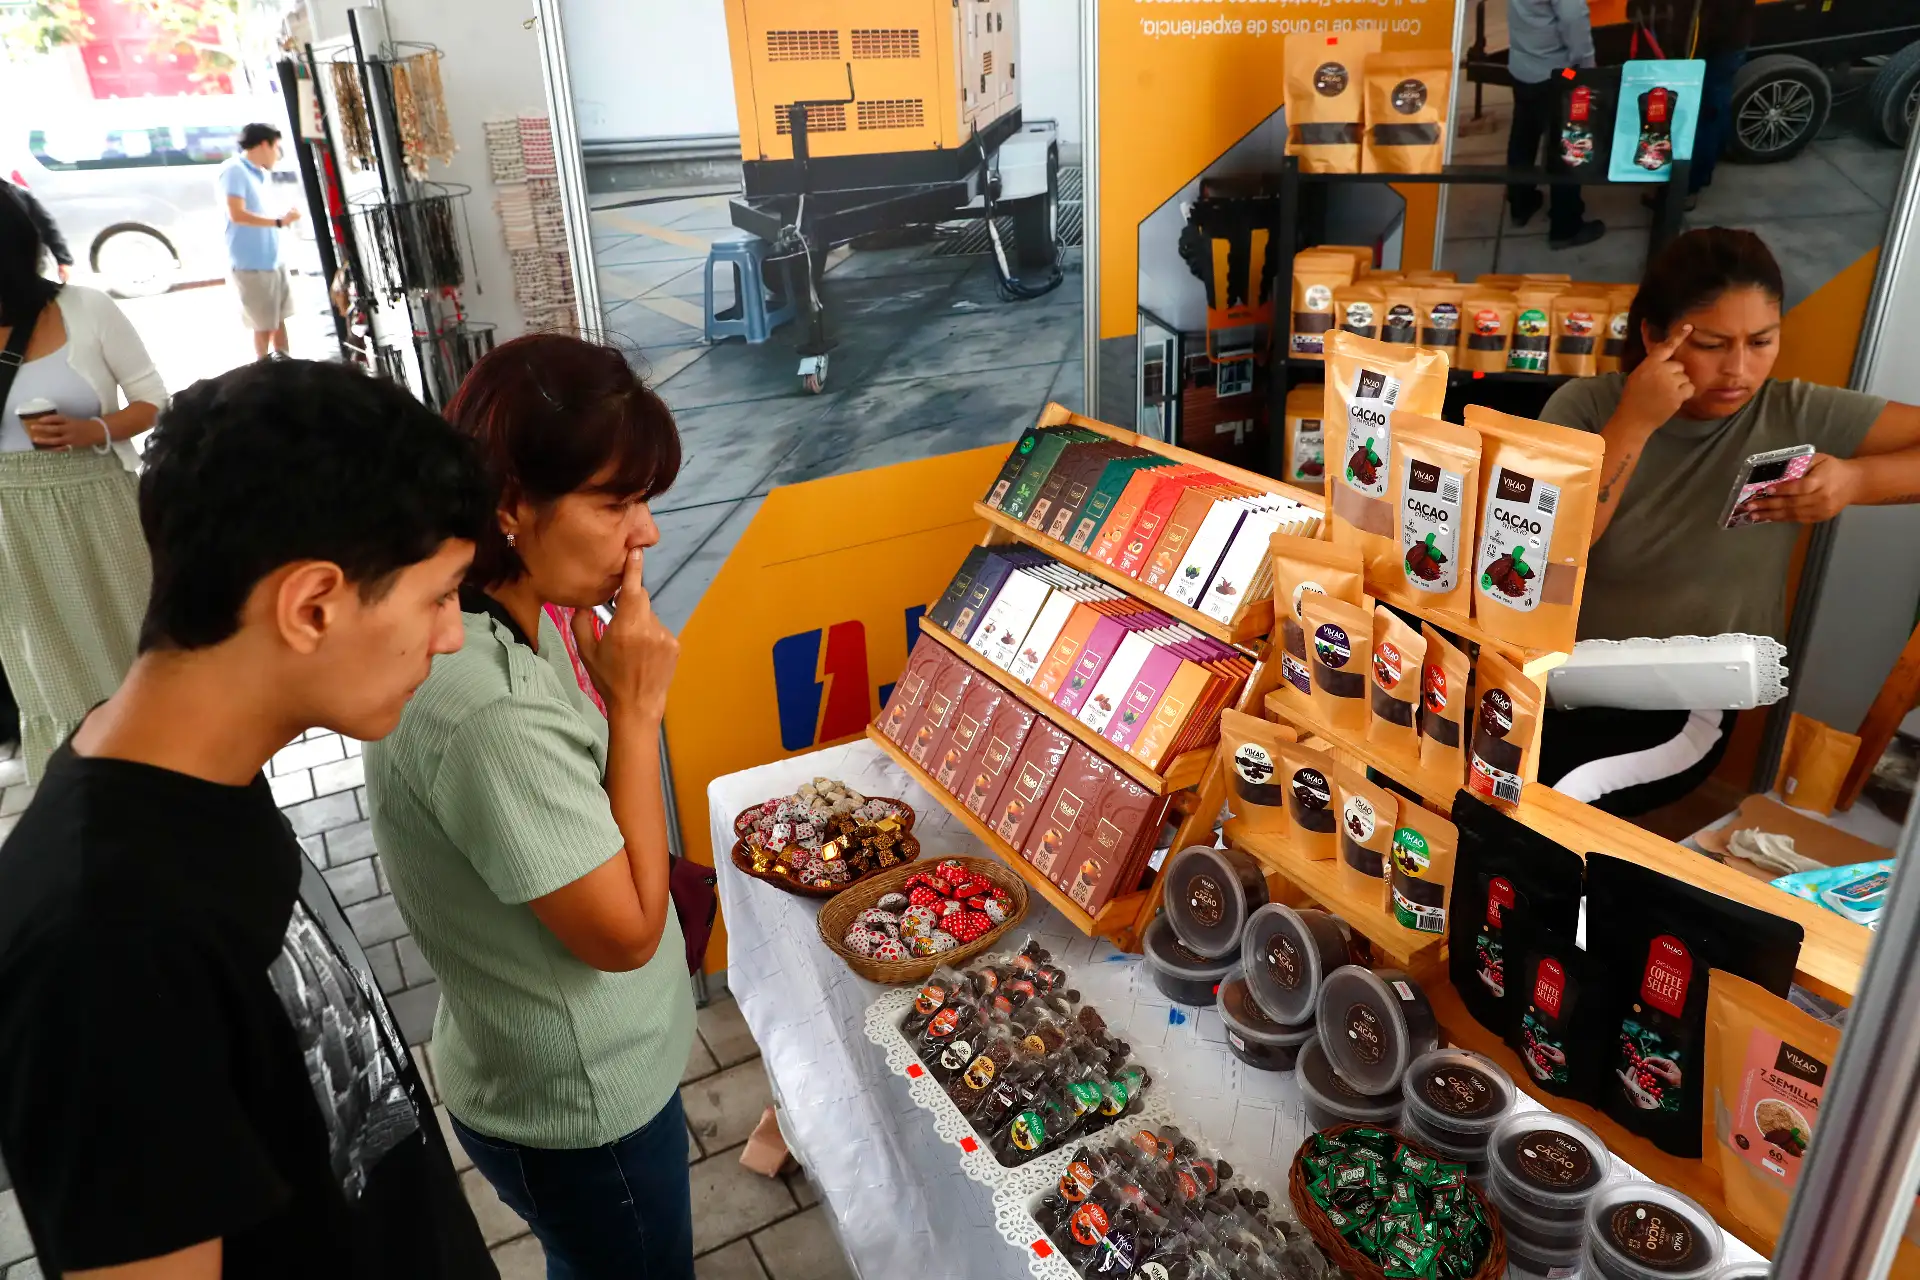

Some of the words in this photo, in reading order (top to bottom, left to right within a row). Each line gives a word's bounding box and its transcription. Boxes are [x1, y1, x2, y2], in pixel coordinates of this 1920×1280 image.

[1140, 13, 1242, 40] experiencia,
[1246, 19, 1268, 38] de
[1392, 17, 1421, 35] Con
[1352, 406, 1386, 426] CACAO
[1414, 469, 1434, 482] VIKAO
[1504, 476, 1526, 492] VIKAO
[1407, 498, 1448, 522] CACAO
[1494, 508, 1542, 535] CACAO
[1324, 625, 1344, 640] VIKAO
[1383, 644, 1400, 661] VIKAO
[1491, 690, 1510, 710] VIKAO
[1244, 747, 1265, 759] VIKAO
[1024, 773, 1037, 787] VIKAO
[1302, 772, 1323, 785] VIKAO
[1060, 800, 1075, 816] VIKAO
[1355, 798, 1372, 815] VIKAO
[1402, 830, 1424, 848] VIKAO
[1194, 891, 1216, 907] CACAO
[1662, 941, 1683, 956] VIKAO
[1274, 949, 1294, 972] CACAO
[1650, 965, 1683, 990] COFFEE
[1539, 980, 1560, 996] COFFEE
[1647, 977, 1682, 1001] SELECT
[1536, 988, 1559, 1007] SELECT
[1353, 1022, 1377, 1043] CACAO
[1786, 1050, 1818, 1074] VIKAO
[1448, 1077, 1474, 1102] CACAO
[1471, 1076, 1486, 1092] VIKAO
[1030, 1115, 1042, 1135] VIKAO
[1556, 1137, 1577, 1152] VIKAO
[1536, 1145, 1574, 1168] CACAO
[1768, 1149, 1783, 1160] 60
[1076, 1164, 1091, 1179] VIKAO
[1340, 1167, 1365, 1181] COCA
[1090, 1204, 1106, 1226] VIKAO
[1646, 1217, 1661, 1250] CACAO
[1674, 1233, 1684, 1251] VIKAO
[1395, 1238, 1421, 1254] COCA
